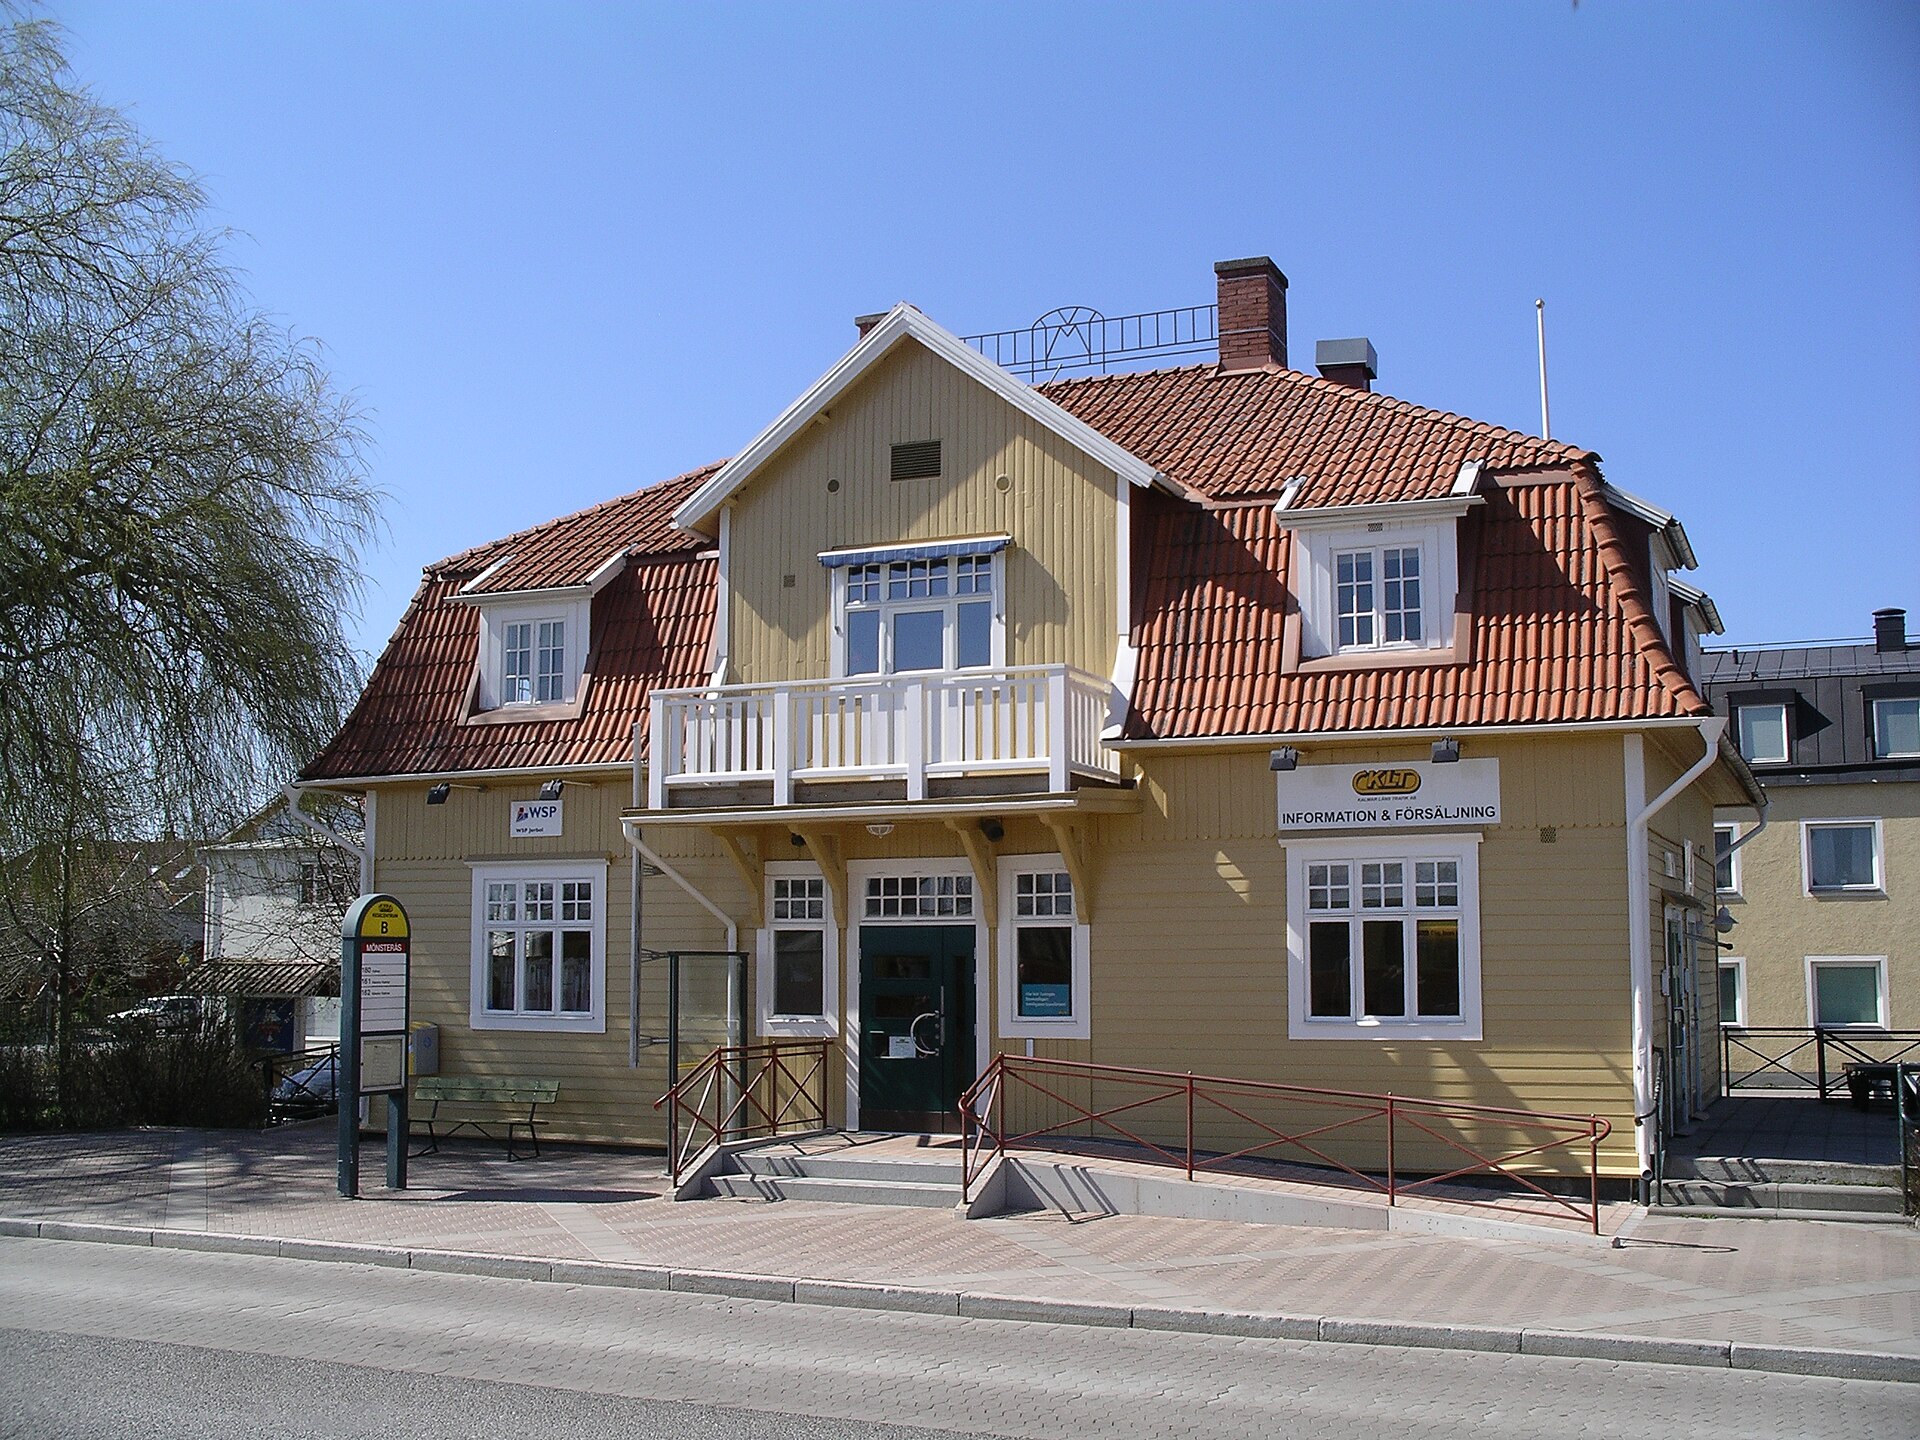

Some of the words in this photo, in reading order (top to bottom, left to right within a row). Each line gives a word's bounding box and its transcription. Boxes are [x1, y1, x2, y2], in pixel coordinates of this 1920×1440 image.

[529, 806, 557, 818] WSP
[1282, 810, 1377, 825] INFORMATION
[1381, 809, 1391, 821] &
[1395, 805, 1496, 821] FÖRSÄLJNING
[381, 921, 389, 934] B
[366, 942, 402, 952] MÖNSTERÅS
